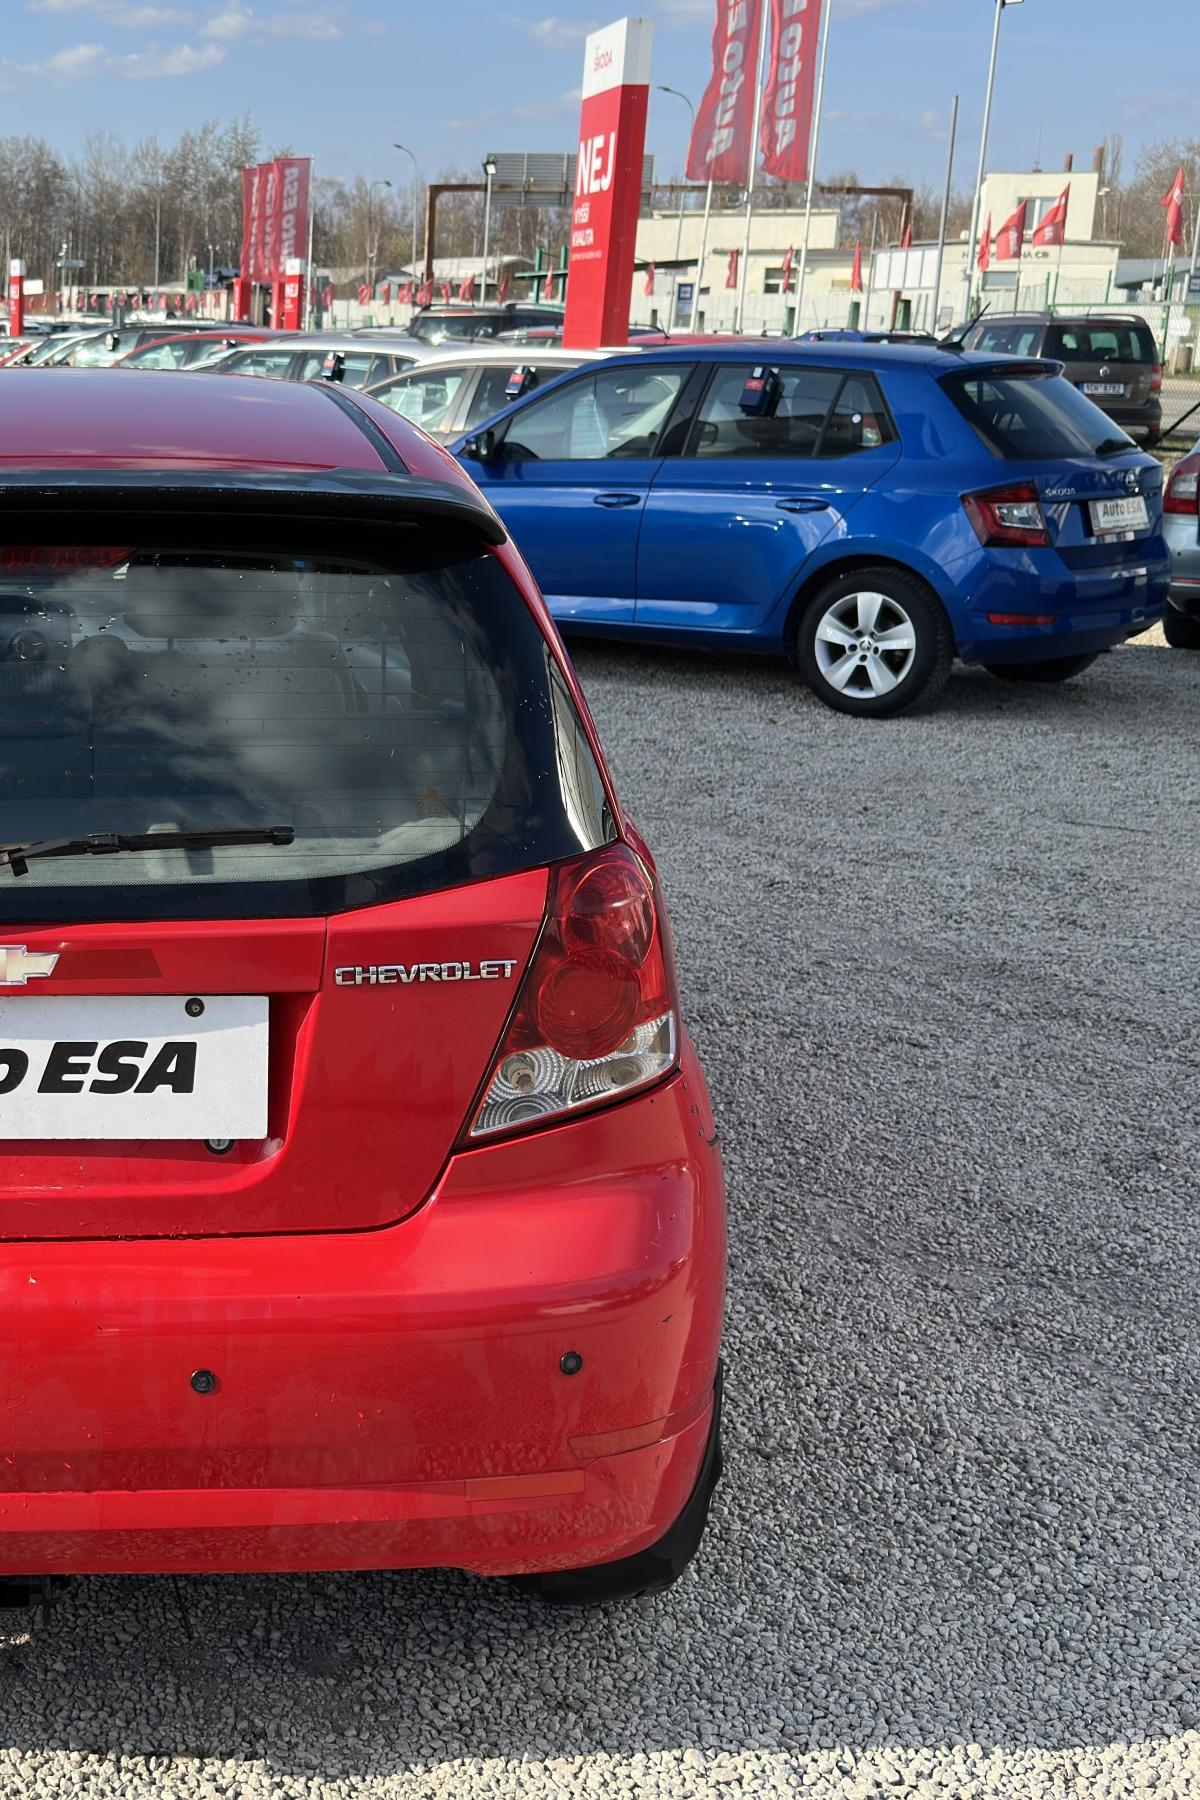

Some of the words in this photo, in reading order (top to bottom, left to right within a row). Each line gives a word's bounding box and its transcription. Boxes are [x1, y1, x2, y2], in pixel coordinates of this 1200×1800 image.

[576, 131, 615, 196] NEJ
[1102, 503, 1126, 518] Auto
[335, 960, 518, 986] CHEVROLET
[37, 1040, 197, 1095] ESA
